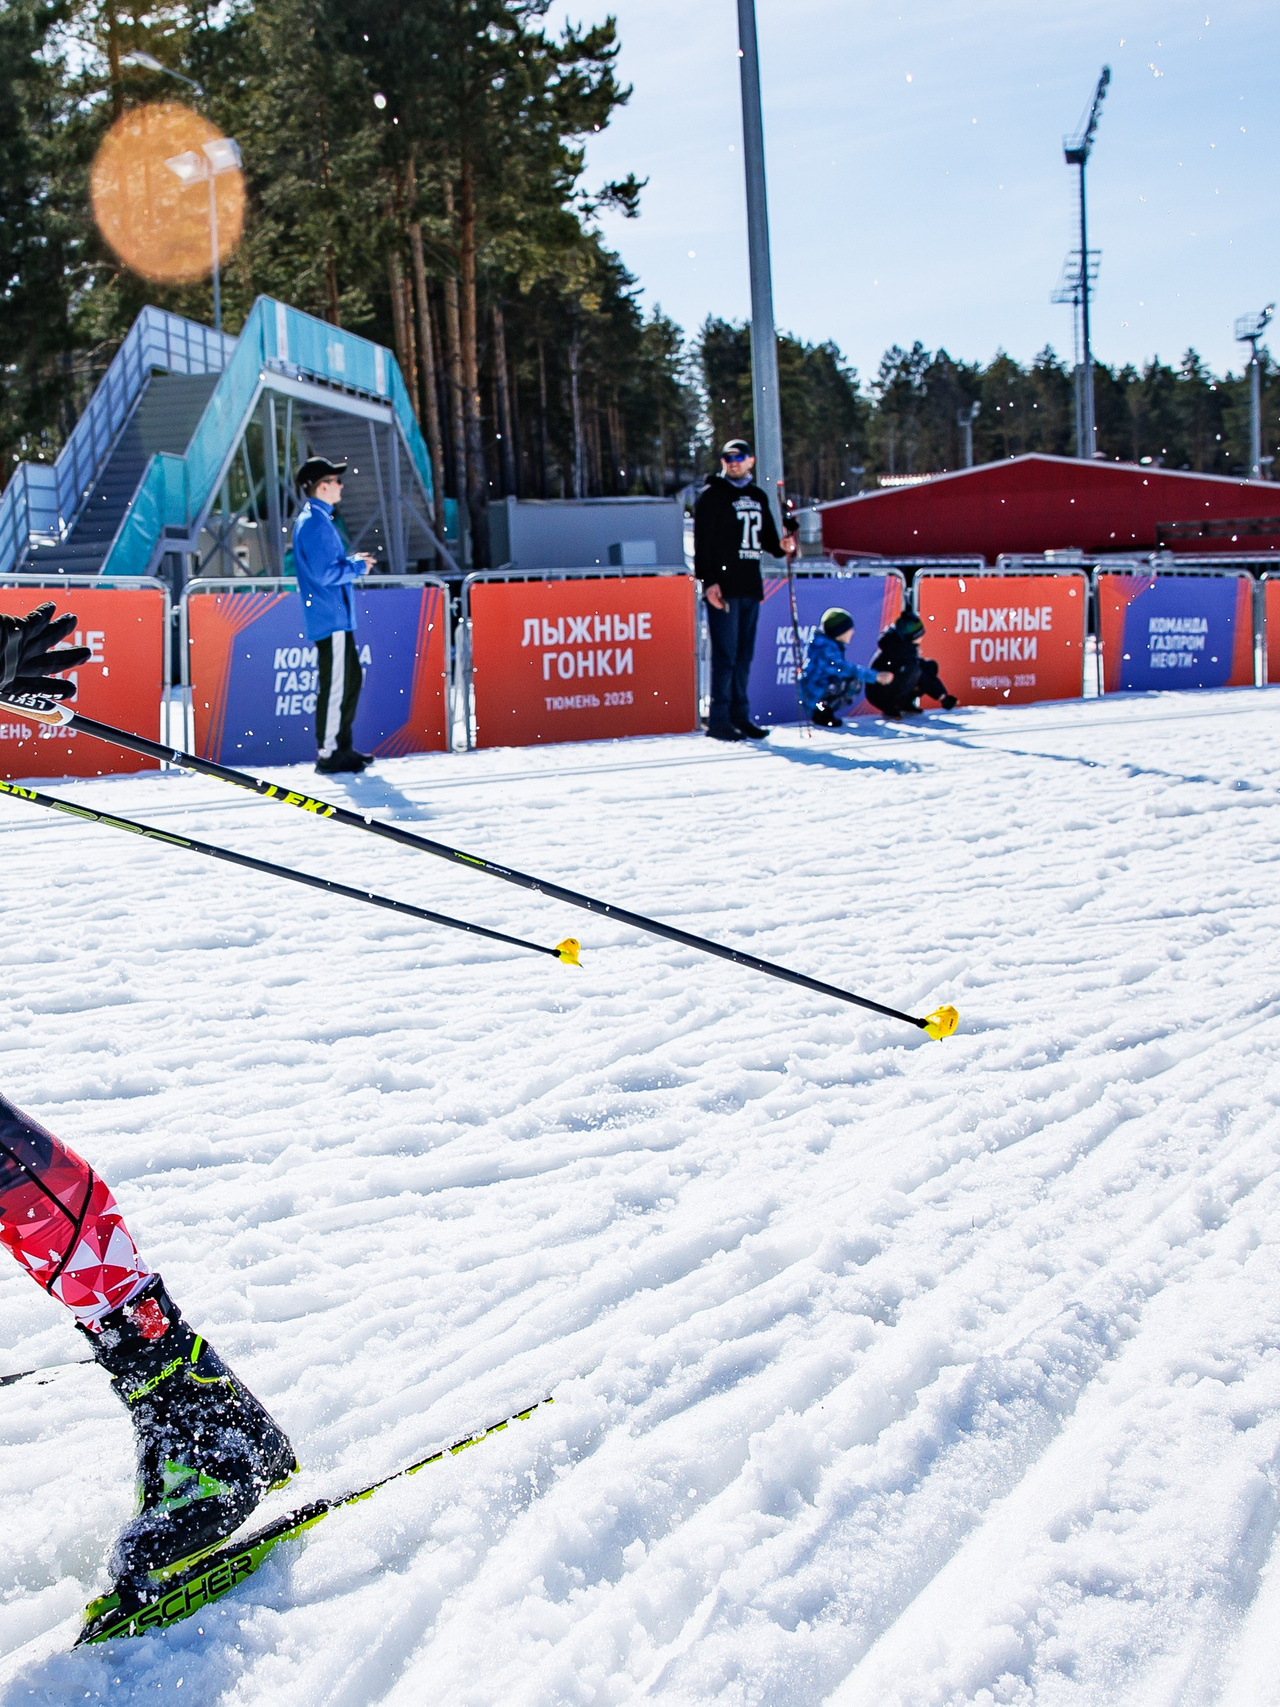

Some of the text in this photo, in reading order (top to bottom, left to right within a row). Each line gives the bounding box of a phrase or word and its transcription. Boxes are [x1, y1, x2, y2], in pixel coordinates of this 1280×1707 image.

[736, 510, 763, 549] 72
[521, 612, 652, 647] ЛЫЖНЫЕ
[954, 606, 1053, 633] ЛЫЖНЫЕ
[1148, 617, 1208, 633] КОМАНДА
[970, 636, 1037, 663] ГОНКИ
[1149, 634, 1205, 651] ГАЗПРОМ
[273, 643, 372, 670] КОМА
[542, 647, 634, 681] ГОНКИ
[7, 694, 47, 710] LEKI
[544, 690, 634, 711] ТЮМЕНЬ 2025
